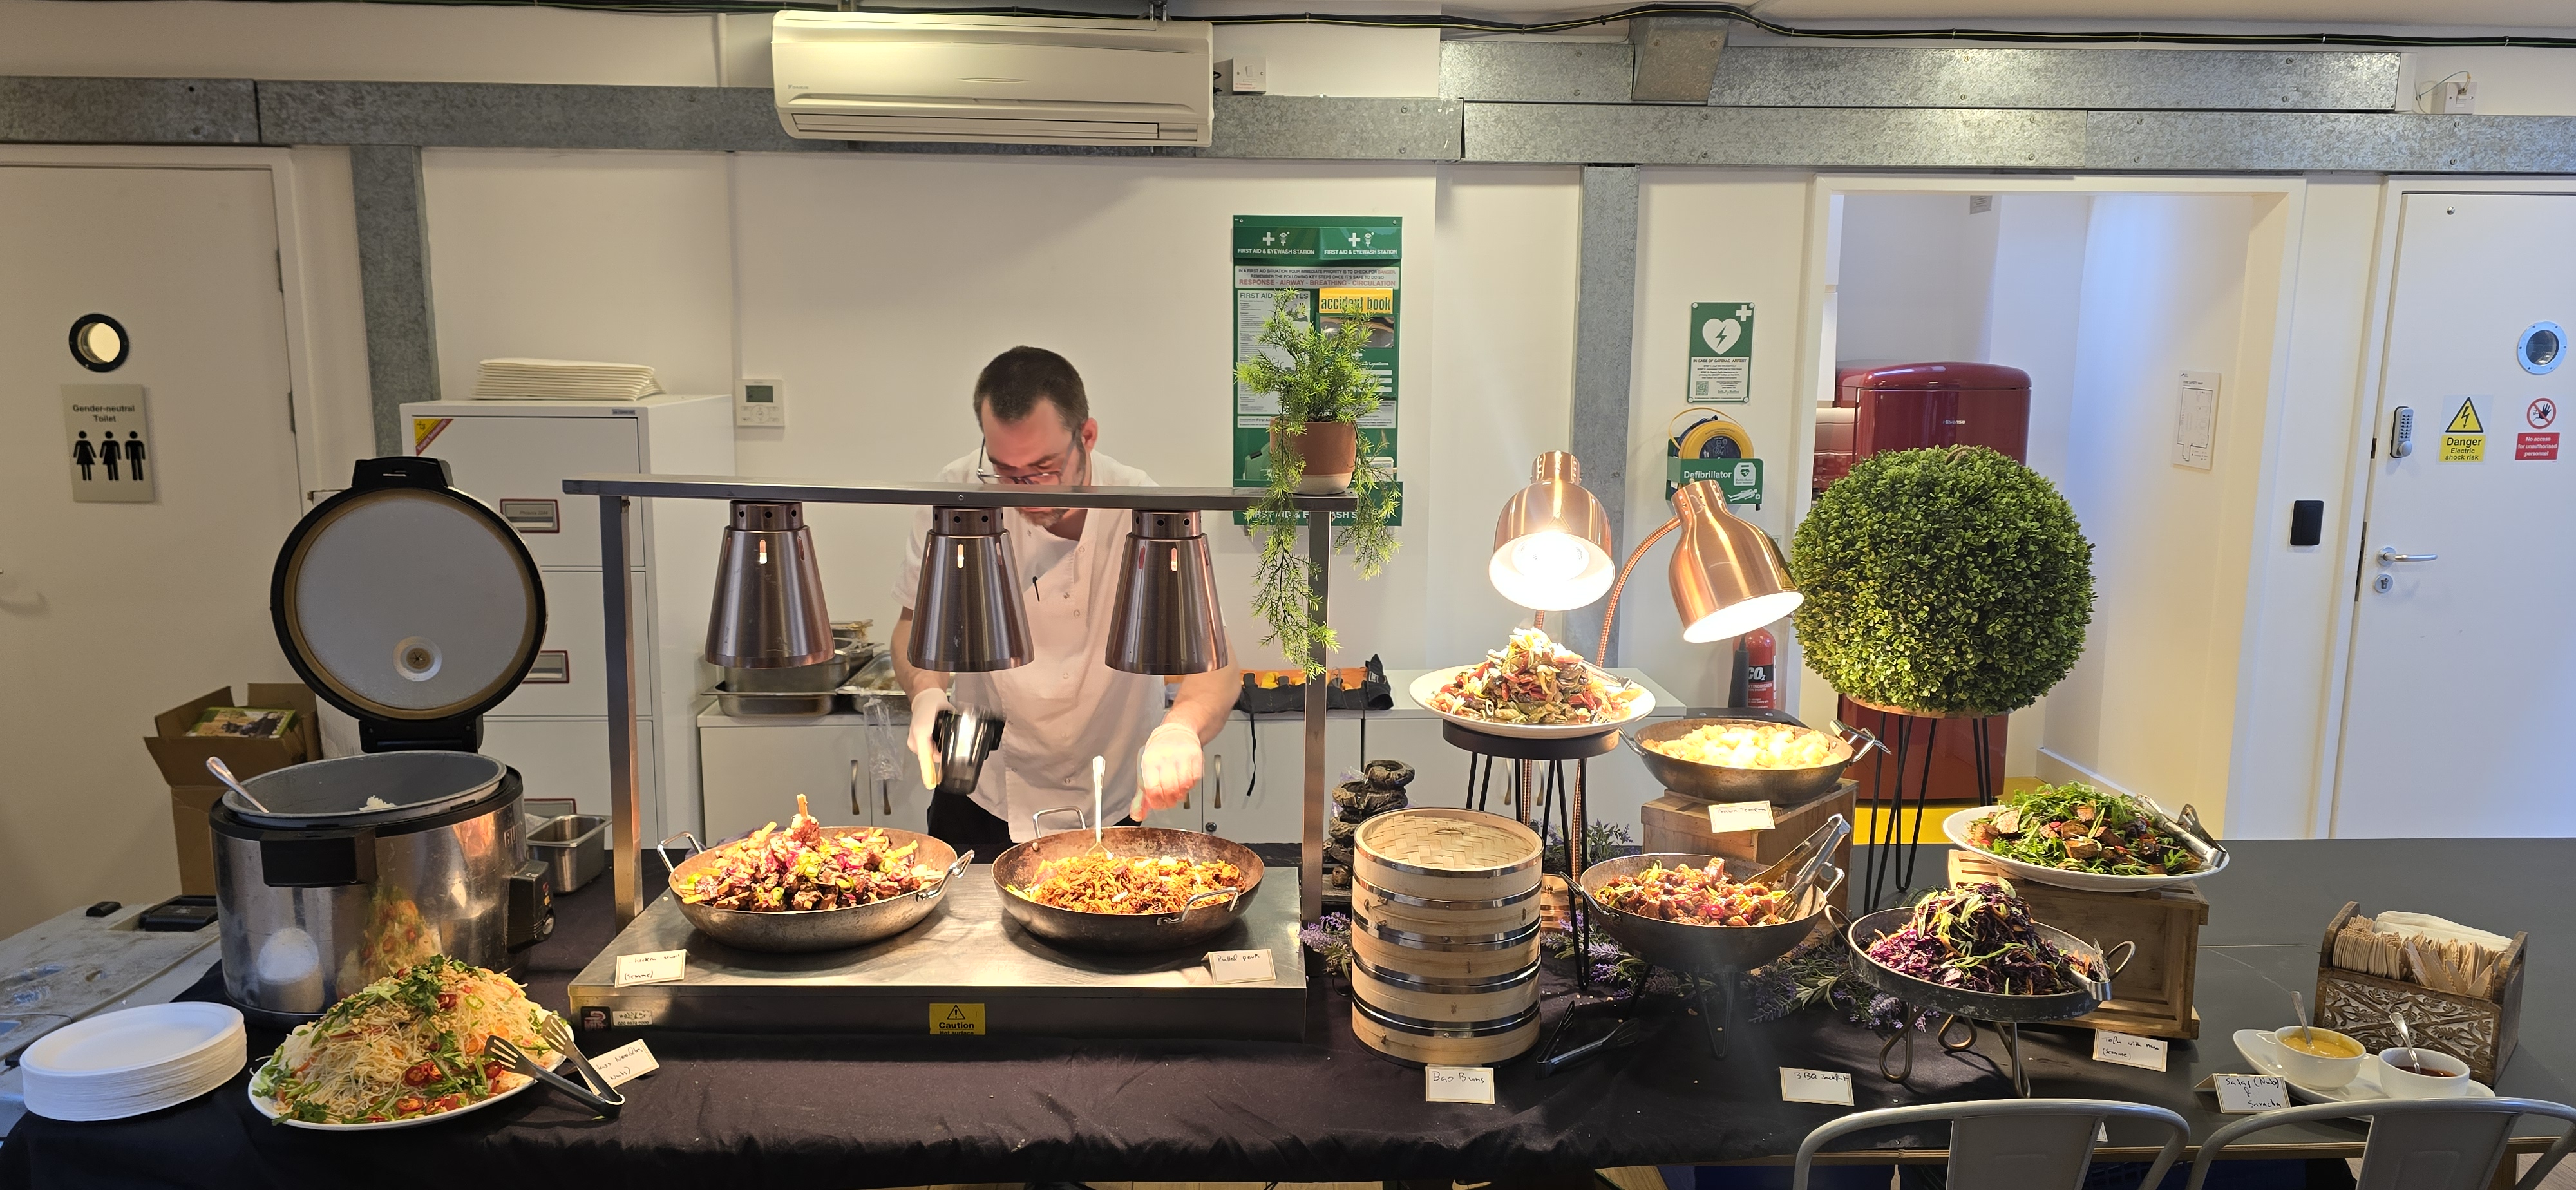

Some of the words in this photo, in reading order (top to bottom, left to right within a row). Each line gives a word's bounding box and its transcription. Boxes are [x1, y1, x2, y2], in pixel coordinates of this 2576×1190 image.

[1367, 296, 1391, 310] book
[93, 414, 117, 422] Toilet
[2447, 437, 2483, 448] Danger
[1217, 954, 1238, 962] Pulled
[1242, 953, 1260, 962] pork
[1432, 1071, 1454, 1082] Bao
[1458, 1072, 1485, 1084] Buns
